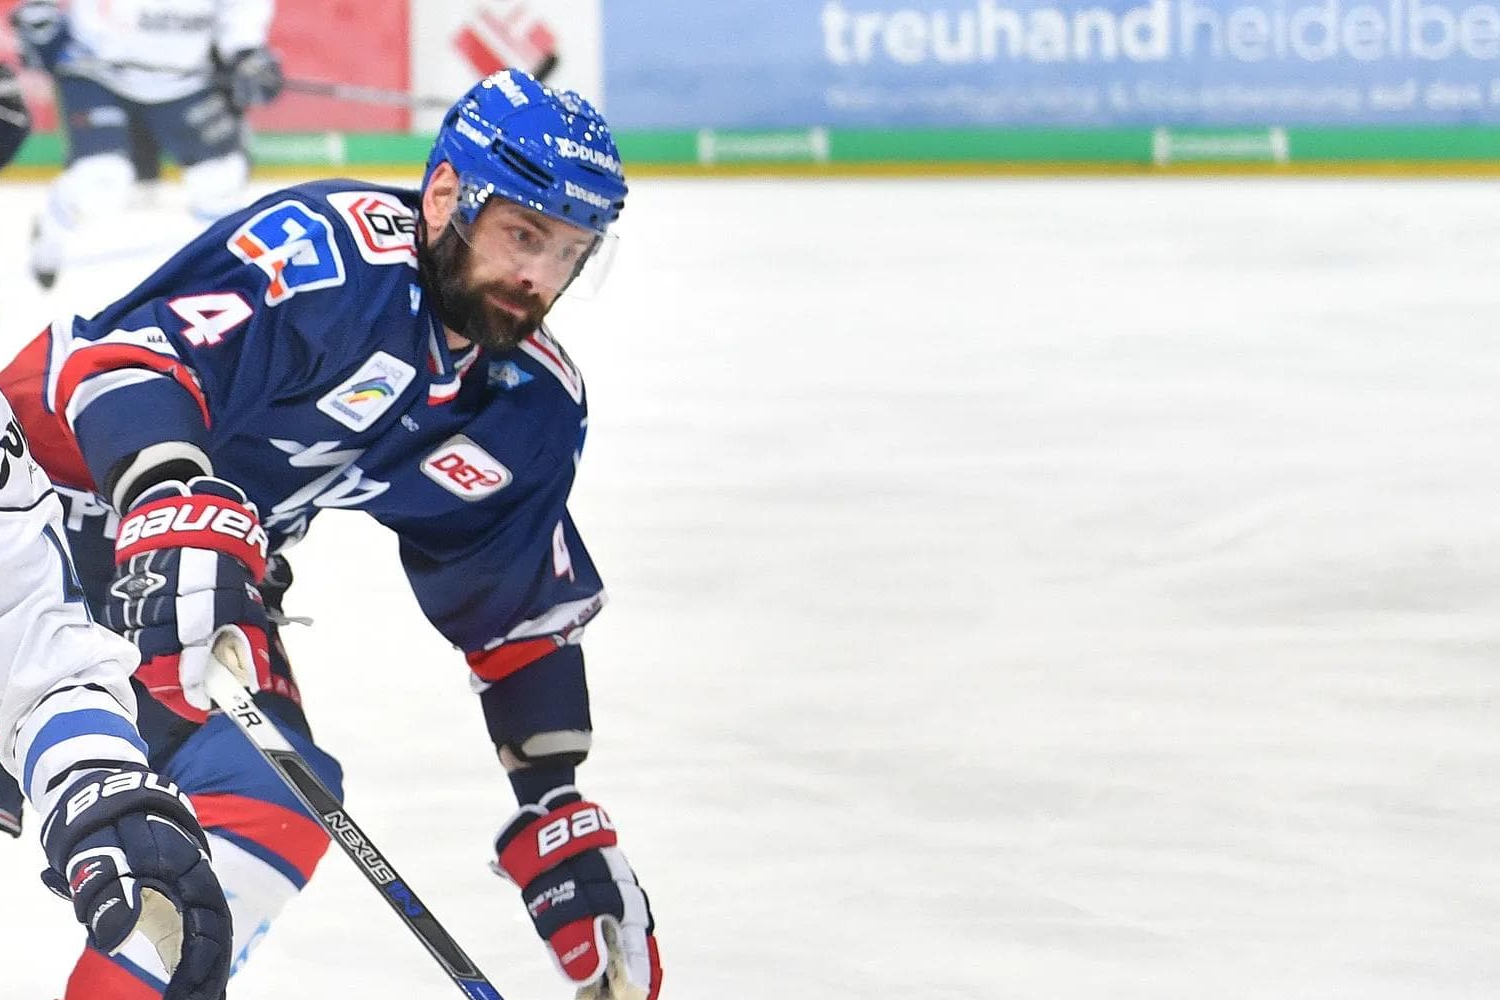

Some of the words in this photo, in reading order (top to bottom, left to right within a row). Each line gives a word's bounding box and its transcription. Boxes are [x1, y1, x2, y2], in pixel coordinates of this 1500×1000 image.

[167, 293, 253, 347] 4
[430, 452, 501, 491] DEL
[323, 810, 397, 886] NEXUS
